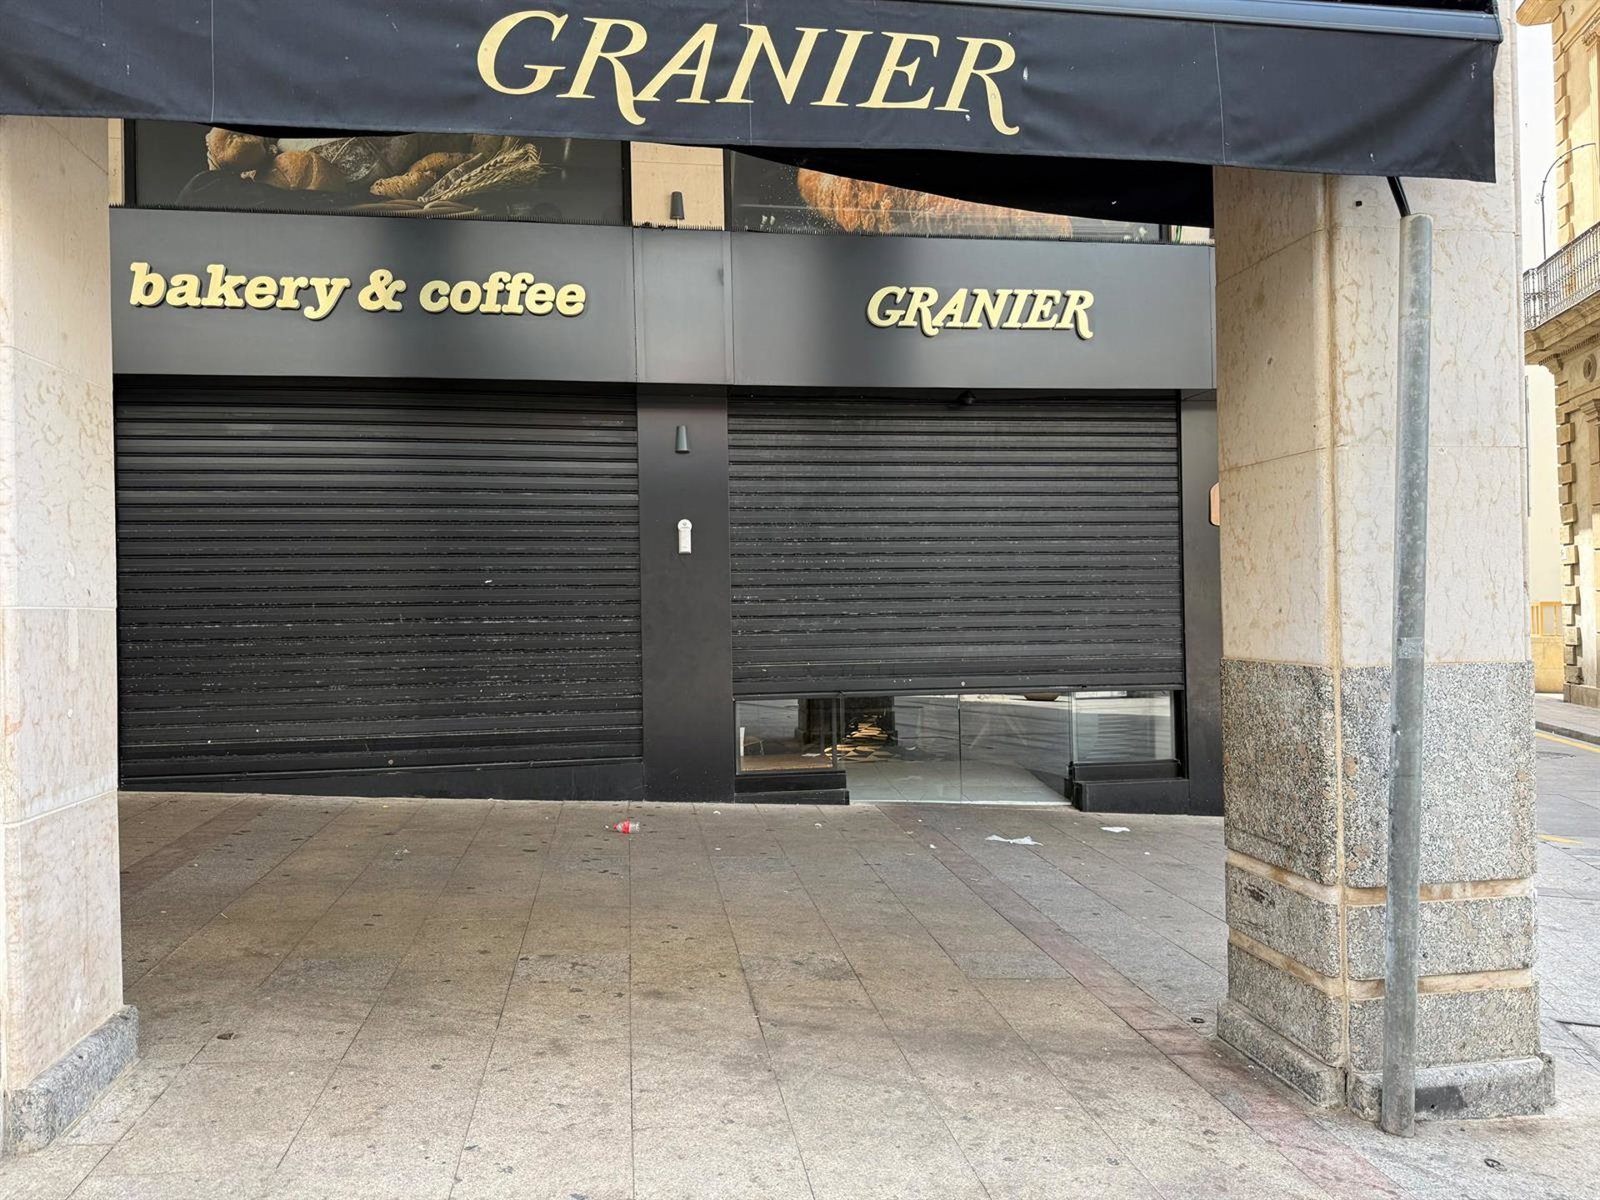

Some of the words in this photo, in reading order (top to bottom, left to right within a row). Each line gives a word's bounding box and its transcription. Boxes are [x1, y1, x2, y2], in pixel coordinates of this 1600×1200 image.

[477, 10, 1020, 136] GRANIER
[129, 262, 351, 321] bakery
[357, 268, 407, 312] &
[419, 271, 587, 317] coffee
[866, 286, 1094, 340] GRANIER
